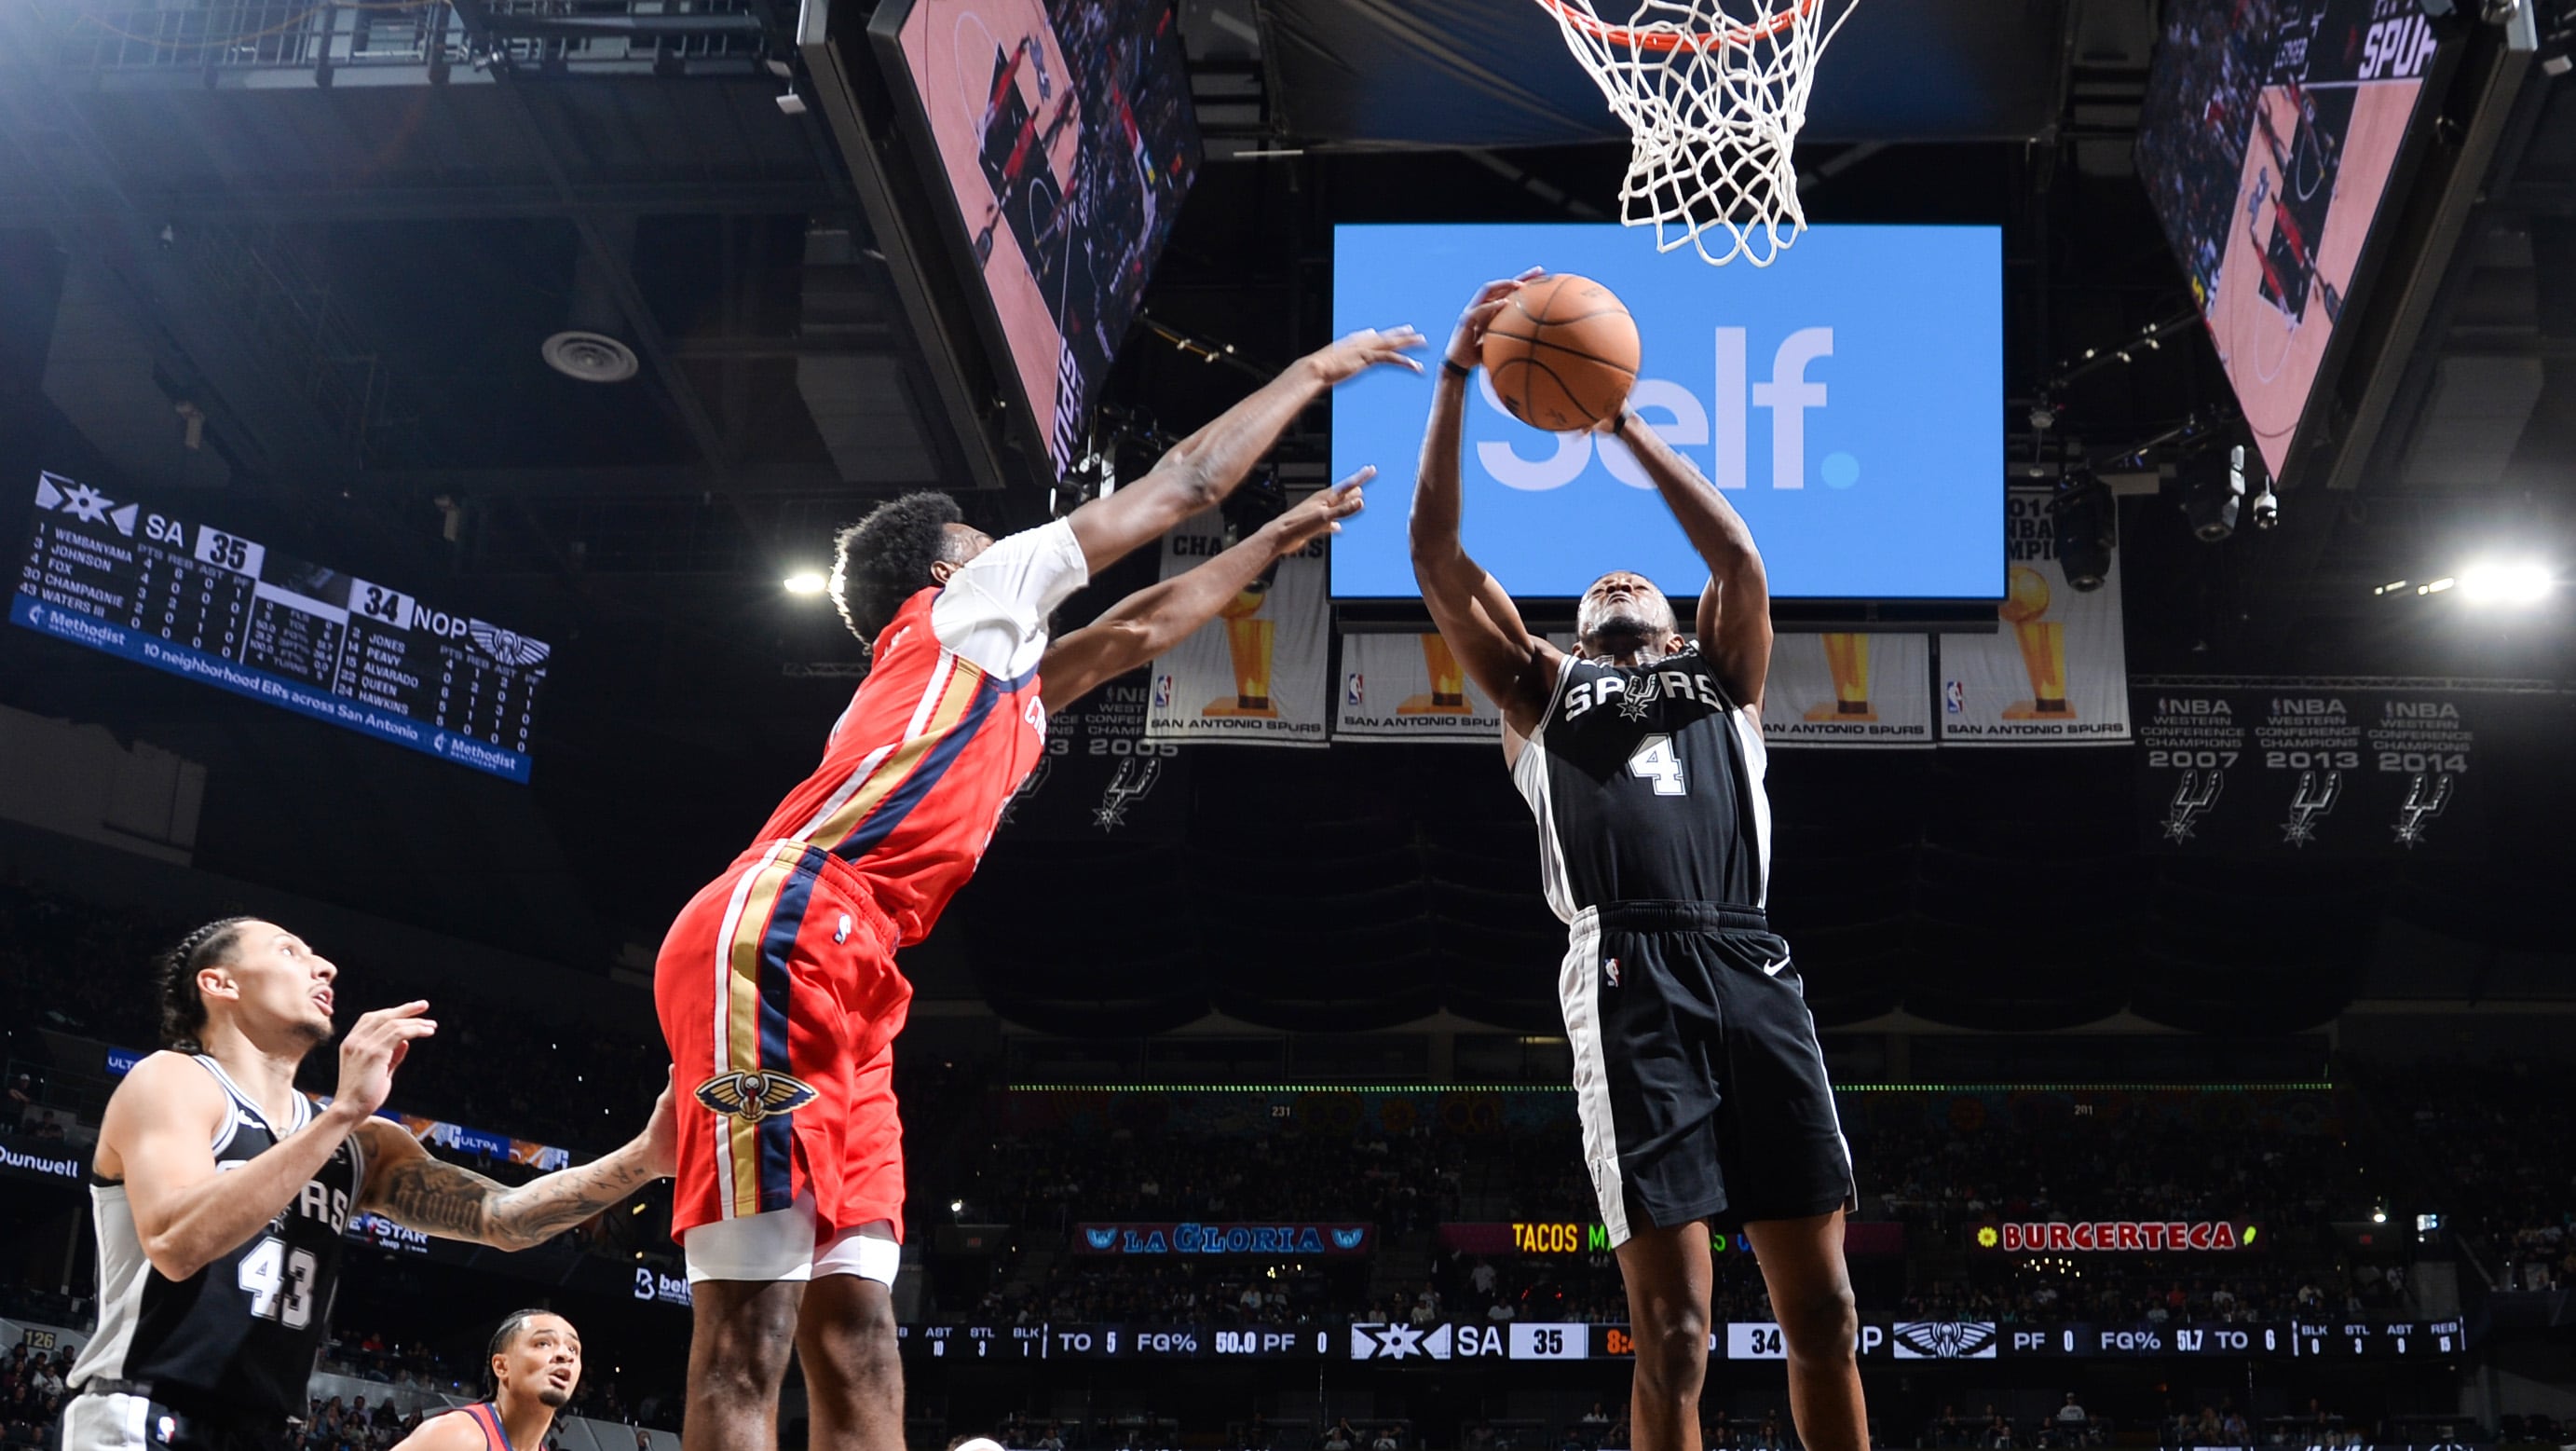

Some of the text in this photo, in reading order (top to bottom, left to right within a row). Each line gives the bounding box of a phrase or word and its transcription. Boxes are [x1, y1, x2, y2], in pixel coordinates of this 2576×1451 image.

[39, 522, 45, 533] 1
[54, 527, 133, 563] WEMBANYAMA
[205, 578, 213, 590] 0
[236, 588, 241, 599] 1
[34, 538, 239, 613] 3 JOHNSON 4 0 0 0
[145, 513, 184, 548] SA
[209, 533, 248, 570] 35
[364, 586, 400, 623] 34
[414, 605, 467, 639] NOP
[48, 558, 73, 575] FOX
[200, 608, 206, 619] 1
[230, 617, 235, 628] 1
[22, 566, 41, 582] 30
[45, 573, 125, 609] CHAMPAGNIE
[165, 612, 174, 624] 0
[198, 623, 203, 633] 1
[225, 631, 234, 644] 0
[20, 582, 37, 597] 43
[41, 588, 91, 613] WATERS
[130, 617, 141, 629] 0
[161, 626, 171, 638] 0
[193, 637, 201, 649] 0
[222, 646, 231, 658] 0
[49, 609, 127, 646] Methodist
[368, 634, 406, 653] JONES
[475, 668, 480, 678] 1
[528, 686, 533, 696] 1
[366, 647, 402, 667] PEAVY
[443, 672, 452, 684] 0
[497, 691, 506, 703] 0
[525, 700, 531, 710] 1
[143, 643, 418, 740] 10 neighborhood ERs across San Antonio
[363, 661, 419, 689] ALVARADO
[470, 697, 475, 706] 1
[522, 713, 530, 725] 0
[1564, 670, 1724, 723] SPURS
[361, 676, 398, 697] QUEEN
[468, 711, 472, 721] 1
[495, 719, 499, 729] 1
[519, 728, 527, 739] 0
[2169, 699, 2232, 715] NBA
[2283, 698, 2347, 715] NBA
[2396, 702, 2460, 719] NBA
[359, 691, 409, 715] HAWKINS
[464, 723, 471, 735] 0
[491, 732, 498, 745] 0
[517, 741, 525, 753] 0
[1152, 718, 1184, 729] SAN
[1188, 719, 1262, 730] ANTONIO
[1266, 720, 1321, 733] SPURS
[1344, 716, 1381, 728] SAN
[1383, 716, 1457, 728] ANTONIO
[1763, 723, 1925, 735] AN ANTONIO SPURS
[1947, 722, 2123, 734] SAN ANTONIO SPURS
[2154, 716, 2231, 725] WESTERN
[2268, 716, 2347, 725] WESTERN
[2380, 719, 2459, 730] WESTERN
[2140, 727, 2245, 736] CONFERENCE
[2255, 726, 2361, 736] CONFERENCE
[2367, 729, 2474, 741] CONFERENCE
[2145, 737, 2242, 747] CHAMPIONS
[2260, 737, 2358, 747] CHAMPIONS
[2373, 740, 2470, 752] CHAMPIONS
[451, 738, 516, 770] Methodist
[2148, 750, 2239, 768] 2007
[2266, 751, 2360, 769] 2013
[2378, 752, 2468, 773] 2014
[1628, 732, 1686, 796] 4
[1272, 1105, 1290, 1117] 231
[375, 1218, 428, 1244] STAR
[1513, 1224, 1577, 1253] TACOS
[2003, 1222, 2236, 1251] BURGERTECA
[238, 1236, 318, 1330] 43
[924, 1327, 1040, 1338] AST STL BLK
[2301, 1321, 2458, 1336] BLK STL AST REB
[25, 1330, 54, 1348] 126
[1023, 1340, 1029, 1357] 1
[1058, 1325, 1781, 1357] TO 5 FG% 50.0 PF 0 SA 35 34
[2014, 1329, 2276, 1352] PF 0 FG% 51.7 TO 6
